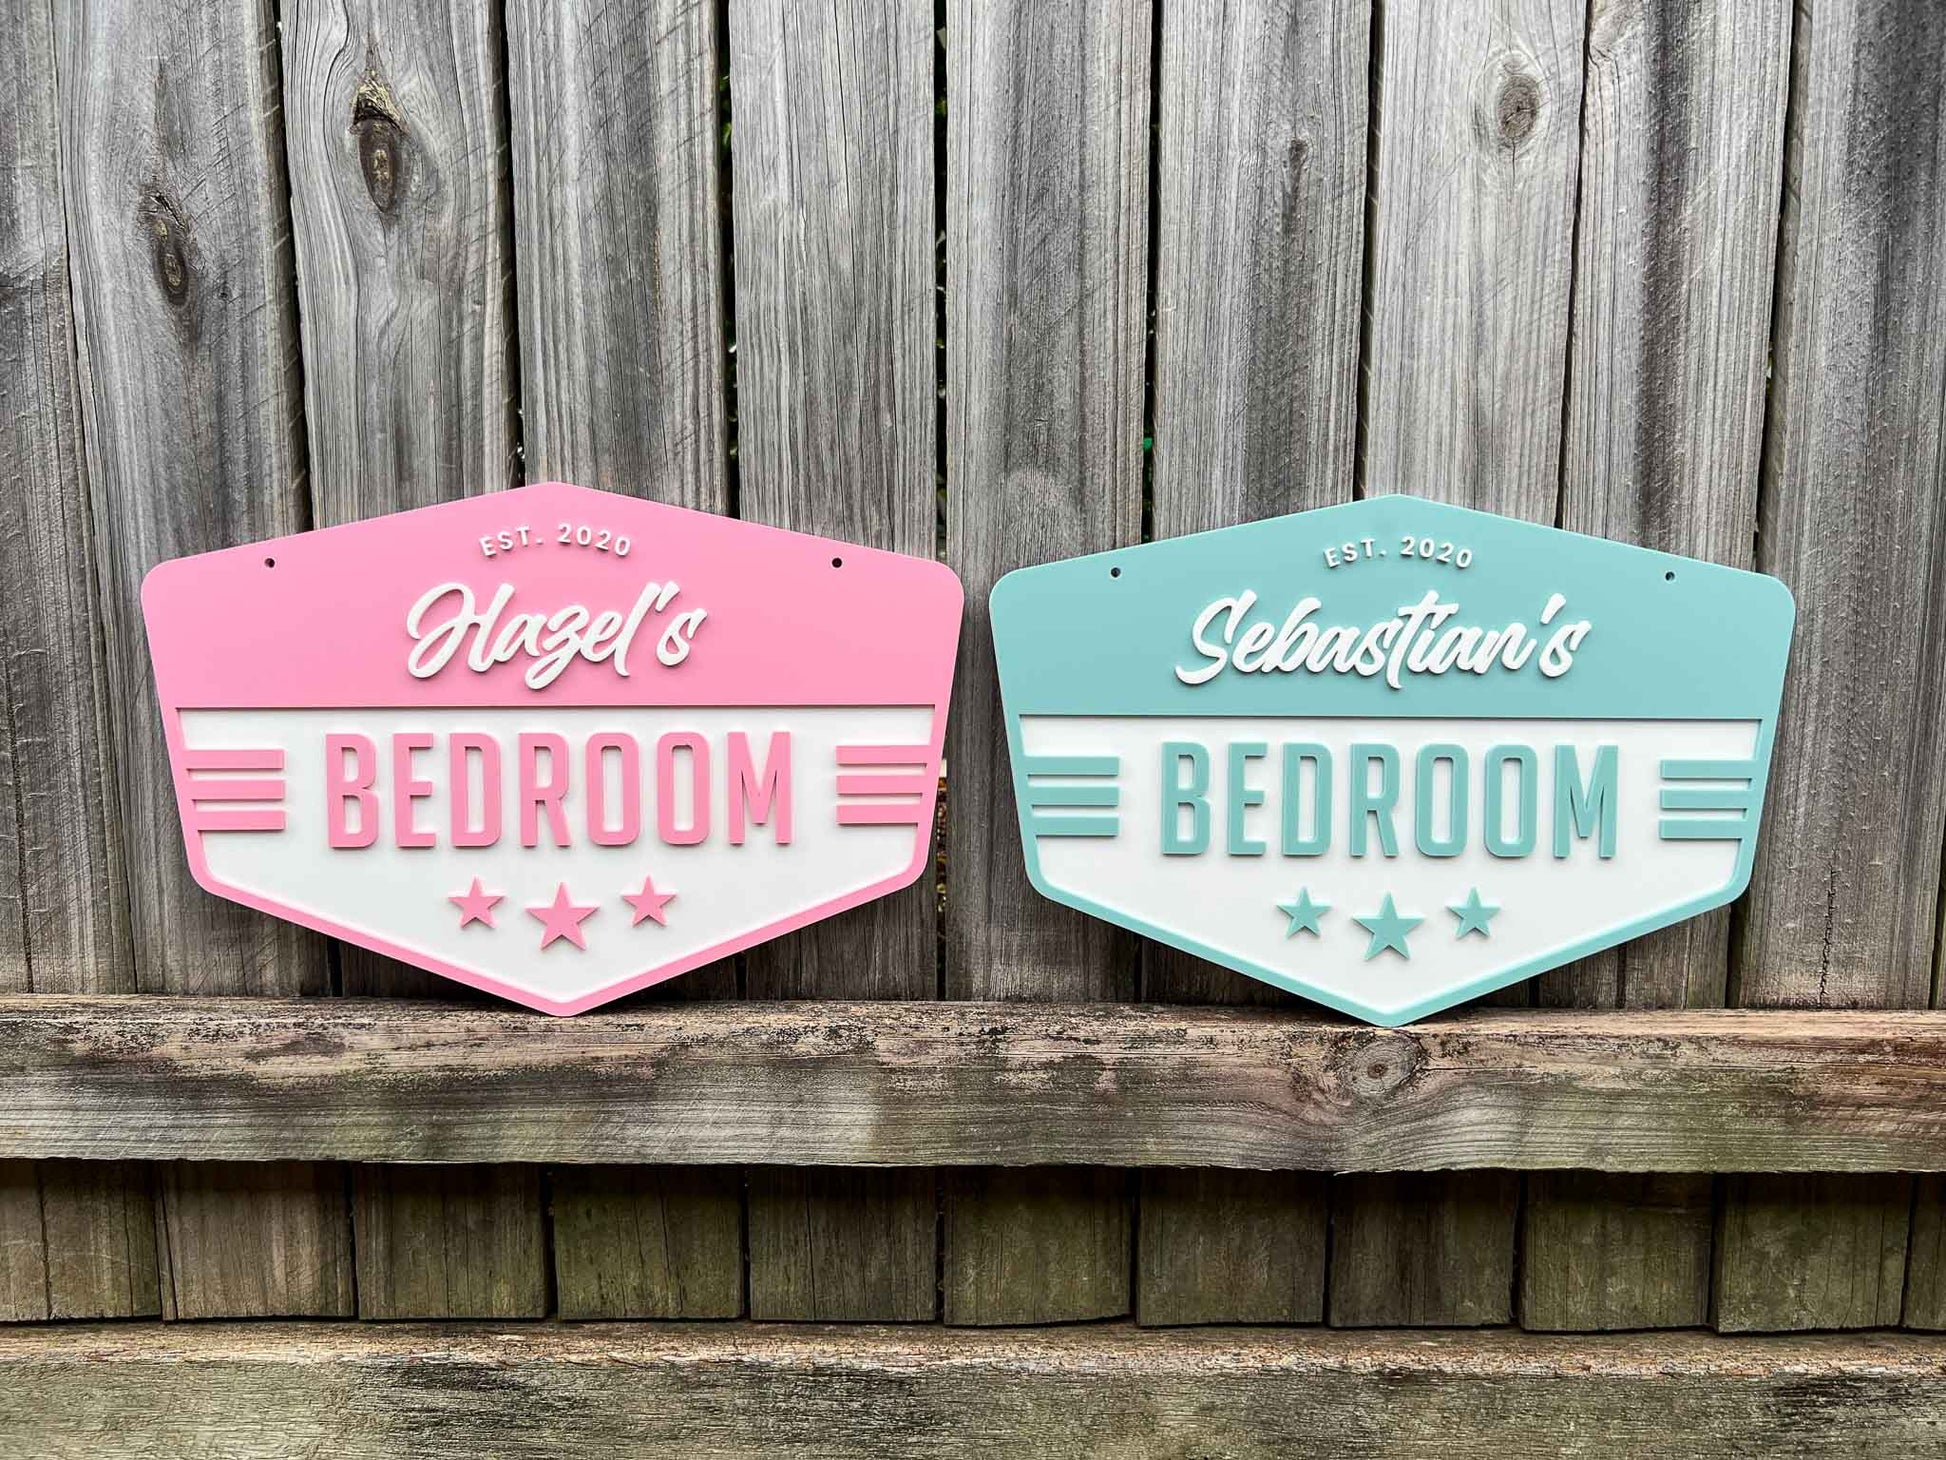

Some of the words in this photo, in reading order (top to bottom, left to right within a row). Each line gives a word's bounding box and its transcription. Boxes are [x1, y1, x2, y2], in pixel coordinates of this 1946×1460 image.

[479, 525, 544, 557] EST.
[558, 522, 632, 557] 2020
[1323, 538, 1387, 570] EST.
[1400, 535, 1474, 569] 2020
[406, 581, 708, 691] Hazel's
[1174, 589, 1592, 690] Sebastian's
[325, 731, 792, 849] BEDROOM
[1160, 741, 1619, 859] BEDROOM
